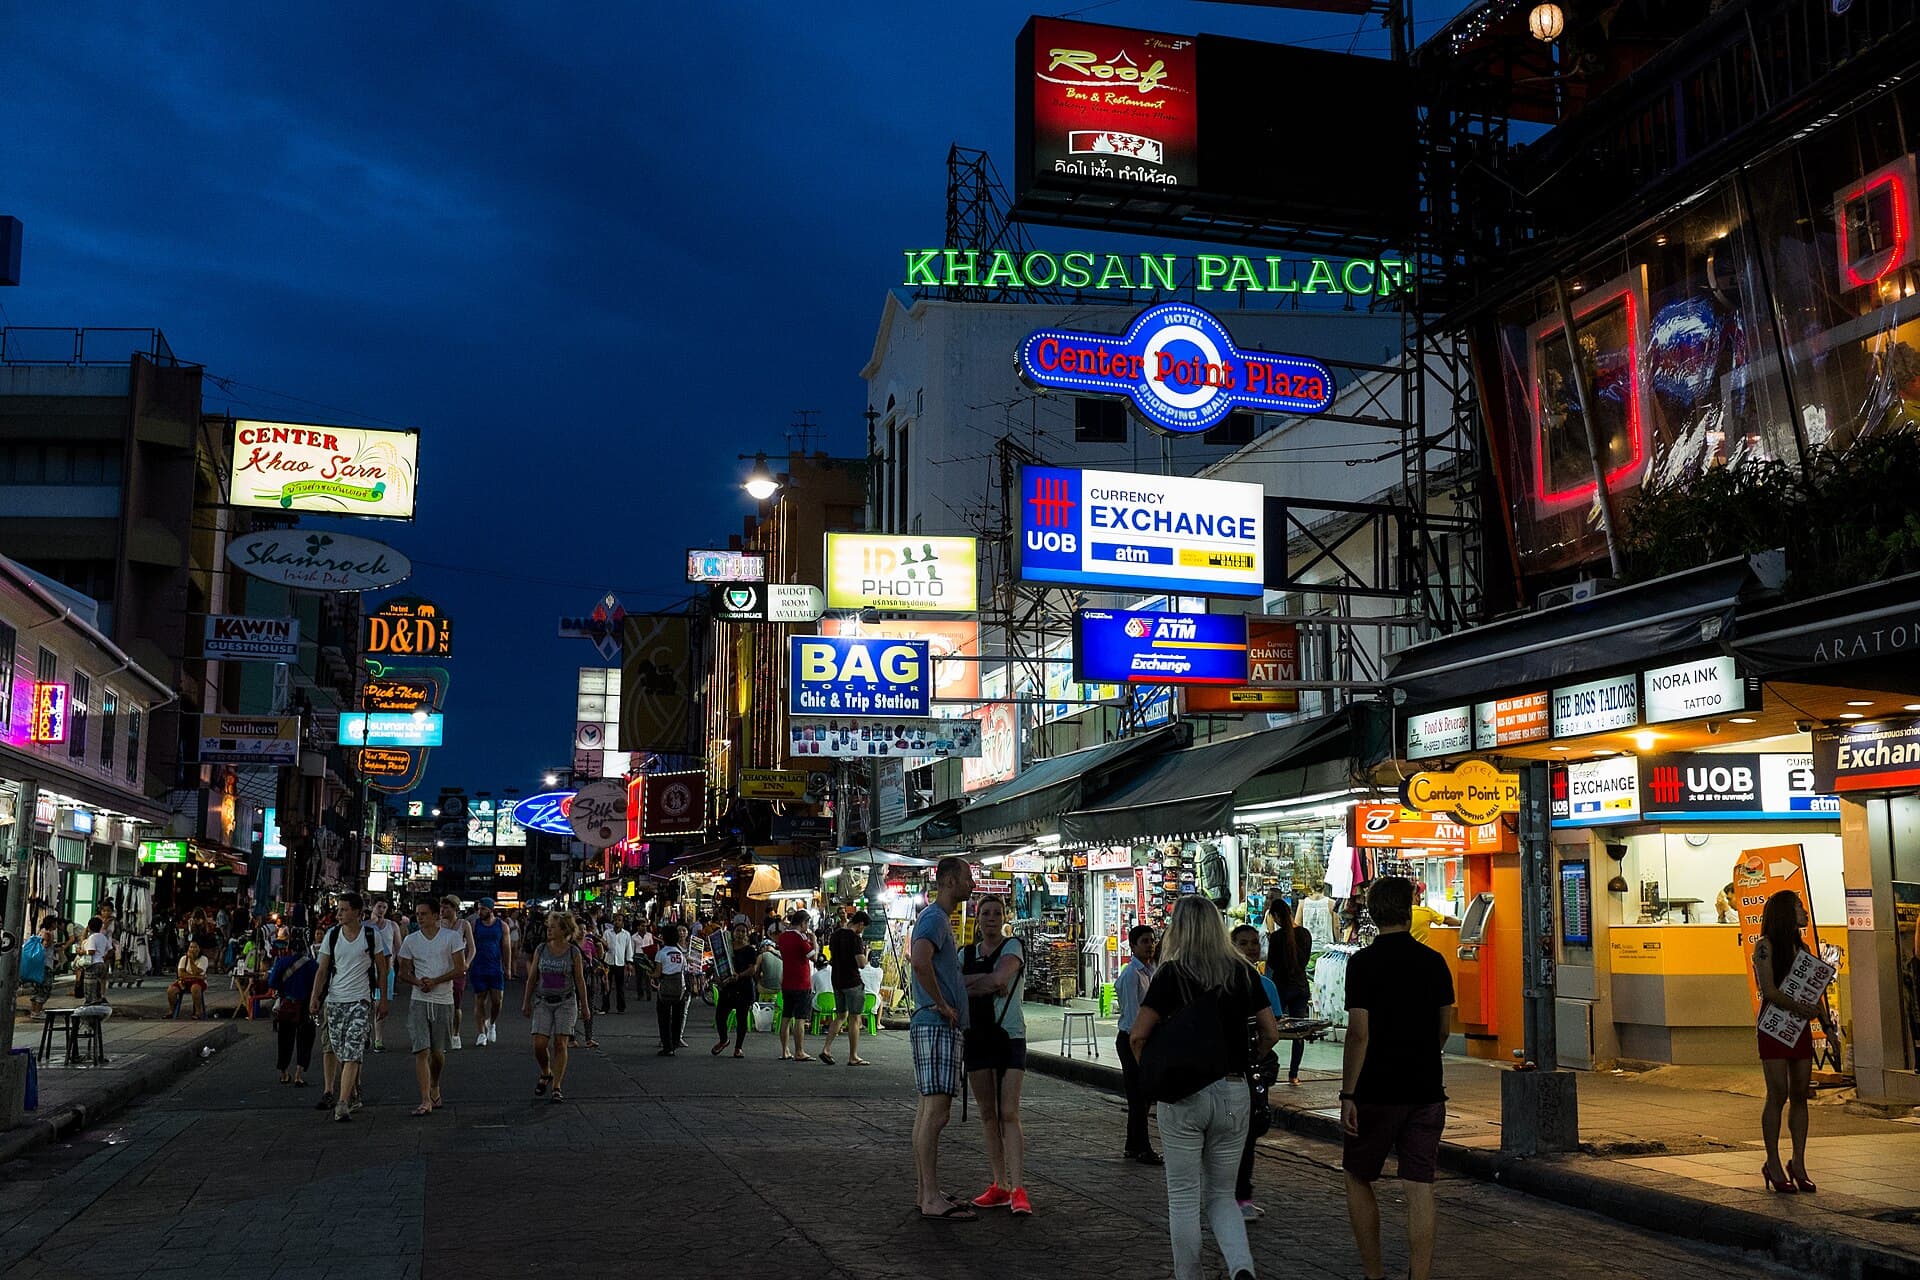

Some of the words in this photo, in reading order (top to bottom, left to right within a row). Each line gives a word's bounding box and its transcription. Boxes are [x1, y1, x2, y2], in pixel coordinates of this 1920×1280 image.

[1049, 48, 1168, 93] Roof
[1066, 88, 1088, 100] Bar
[1090, 92, 1100, 102] &
[1105, 92, 1166, 109] Restaurant
[903, 249, 1175, 291] KHAOSAN
[1197, 254, 1414, 296] PALACE
[1164, 314, 1204, 330] HOTEL
[1038, 338, 1144, 380] Center
[1154, 350, 1236, 389] Point
[1246, 361, 1325, 401] Plaza
[1138, 383, 1198, 420] SHOPPING
[1200, 389, 1230, 418] MALL
[239, 427, 339, 451] CENTER
[236, 447, 315, 474] Khao
[321, 455, 386, 479] Sarn
[1090, 488, 1165, 505] CURRENCY
[1090, 505, 1256, 540] EXCHANGE
[1027, 531, 1077, 552] UOB
[1115, 546, 1149, 563] atm
[244, 543, 390, 574] Shamrock
[689, 557, 728, 577] LUCKY
[734, 557, 764, 577] BEER
[864, 547, 897, 575] ID
[284, 569, 317, 583] Irish
[323, 570, 349, 585] Pub
[777, 588, 814, 596] BUDGET
[862, 580, 943, 596] PHOTO
[775, 610, 818, 618] AVAILABLE
[214, 618, 290, 640] KAWIN
[250, 634, 289, 643] PLACE
[368, 617, 435, 654] D&D
[439, 620, 450, 653] INN
[1154, 624, 1197, 639] ATM
[208, 641, 295, 654] GUESTHOUSE
[1249, 649, 1294, 658] CHANGE
[801, 643, 919, 684] BAG
[1131, 658, 1191, 673] Exchange
[1251, 663, 1295, 680] ATM
[801, 684, 919, 692] LOCKER
[1652, 671, 1691, 692] NORA
[1694, 666, 1718, 684] INK
[800, 691, 827, 708] Chic
[830, 692, 840, 708] &
[844, 691, 870, 712] Trip
[874, 693, 919, 710] Station
[1555, 697, 1572, 719] THE
[1574, 691, 1596, 716] BOSS
[1599, 683, 1636, 712] TAILORS
[1684, 694, 1722, 710] TATTOO
[221, 722, 278, 735] Southeast
[1424, 720, 1437, 735] Food
[1438, 719, 1443, 732] &
[1444, 715, 1469, 733] Beverage
[1610, 713, 1636, 725] HOURS
[1837, 740, 1920, 770] Exchan
[1457, 765, 1491, 778] HOTEL
[1687, 767, 1753, 793] UOB
[1415, 779, 1463, 802] Center
[1468, 786, 1500, 801] Point
[1573, 776, 1635, 795] EXCHANGE
[574, 798, 613, 819] Silk
[1455, 803, 1484, 820] SHOPPING
[1487, 804, 1500, 818] MALL
[1552, 800, 1569, 812] UOB
[1810, 797, 1840, 811] atm
[1435, 824, 1464, 838] ATM
[1478, 823, 1496, 838] ATM
[1742, 896, 1765, 906] BUS
[1764, 1013, 1781, 1032] San
[1793, 955, 1812, 979] Beer
[1778, 1020, 1800, 1042] Buy
[1807, 966, 1828, 989] Free
